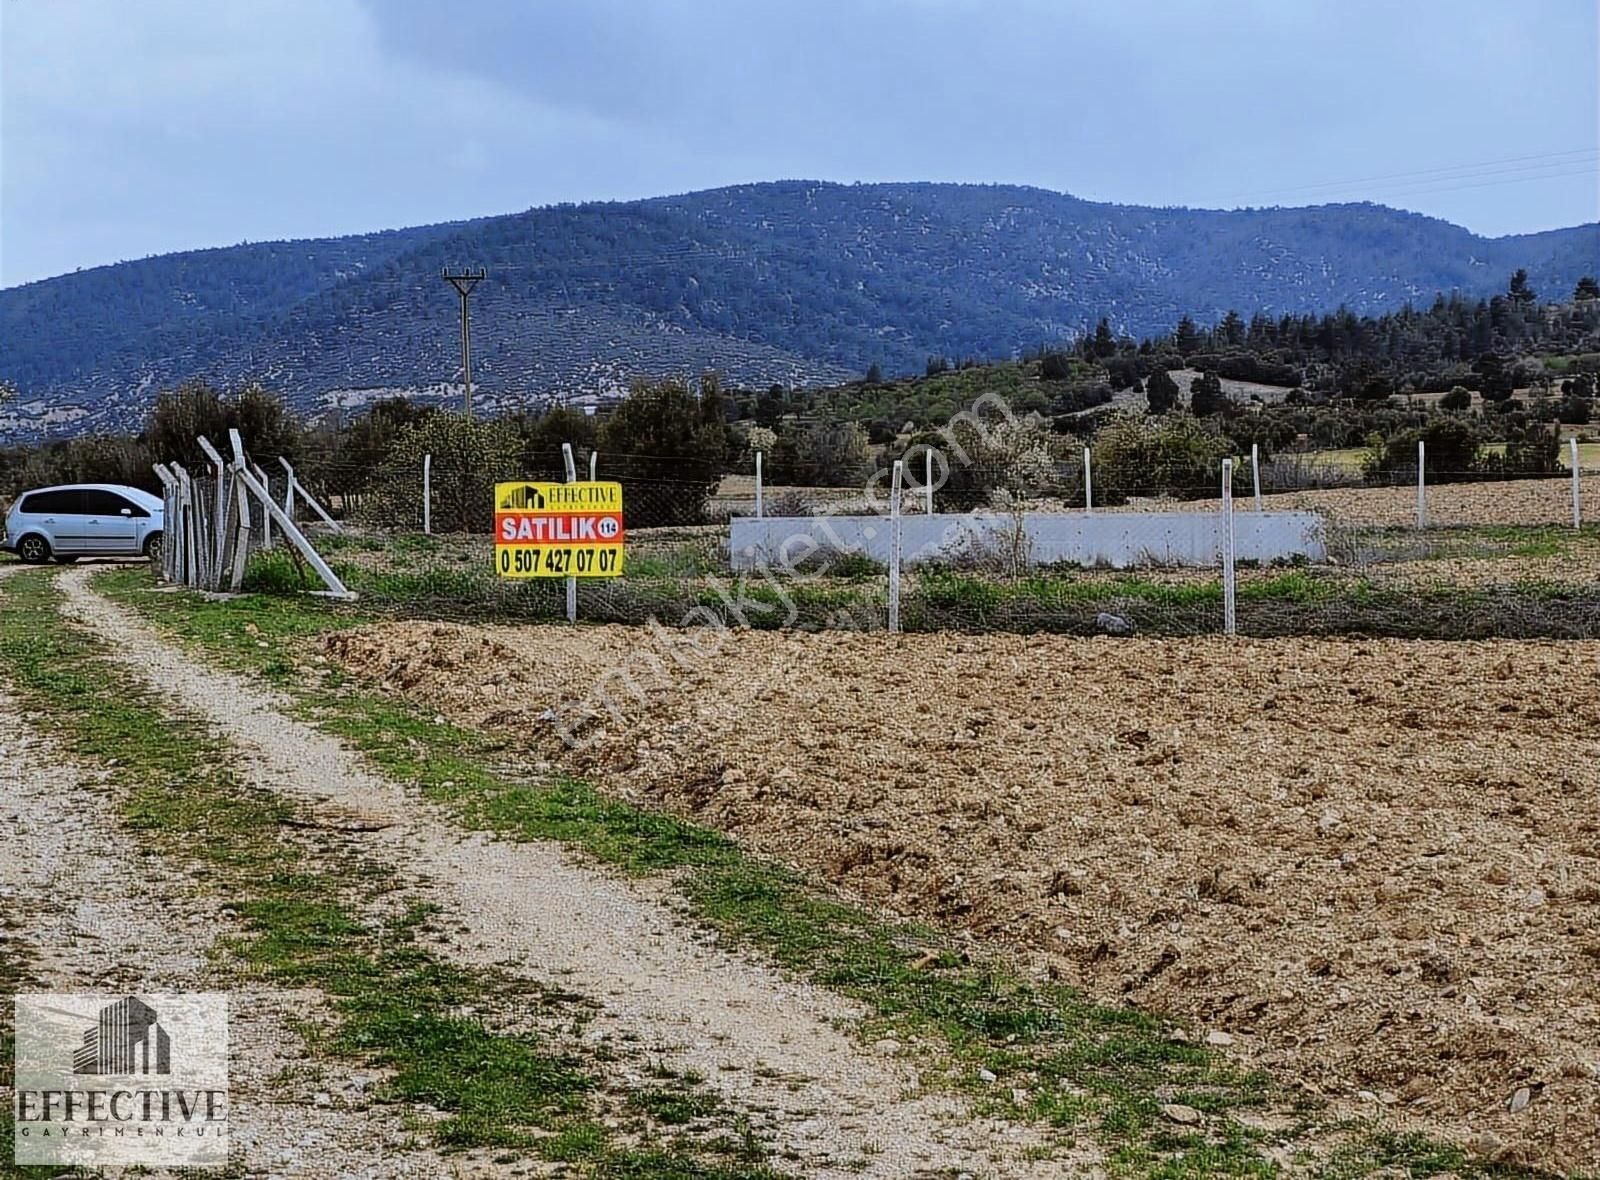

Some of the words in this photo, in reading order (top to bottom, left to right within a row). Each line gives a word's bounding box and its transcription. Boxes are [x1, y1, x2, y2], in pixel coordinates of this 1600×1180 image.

[549, 487, 617, 503] EFFECTIVE
[502, 516, 596, 540] SATILIK
[501, 548, 510, 573] 0
[515, 548, 541, 573] 507
[546, 548, 571, 572] 427
[577, 548, 595, 572] 07
[599, 548, 617, 572] 07
